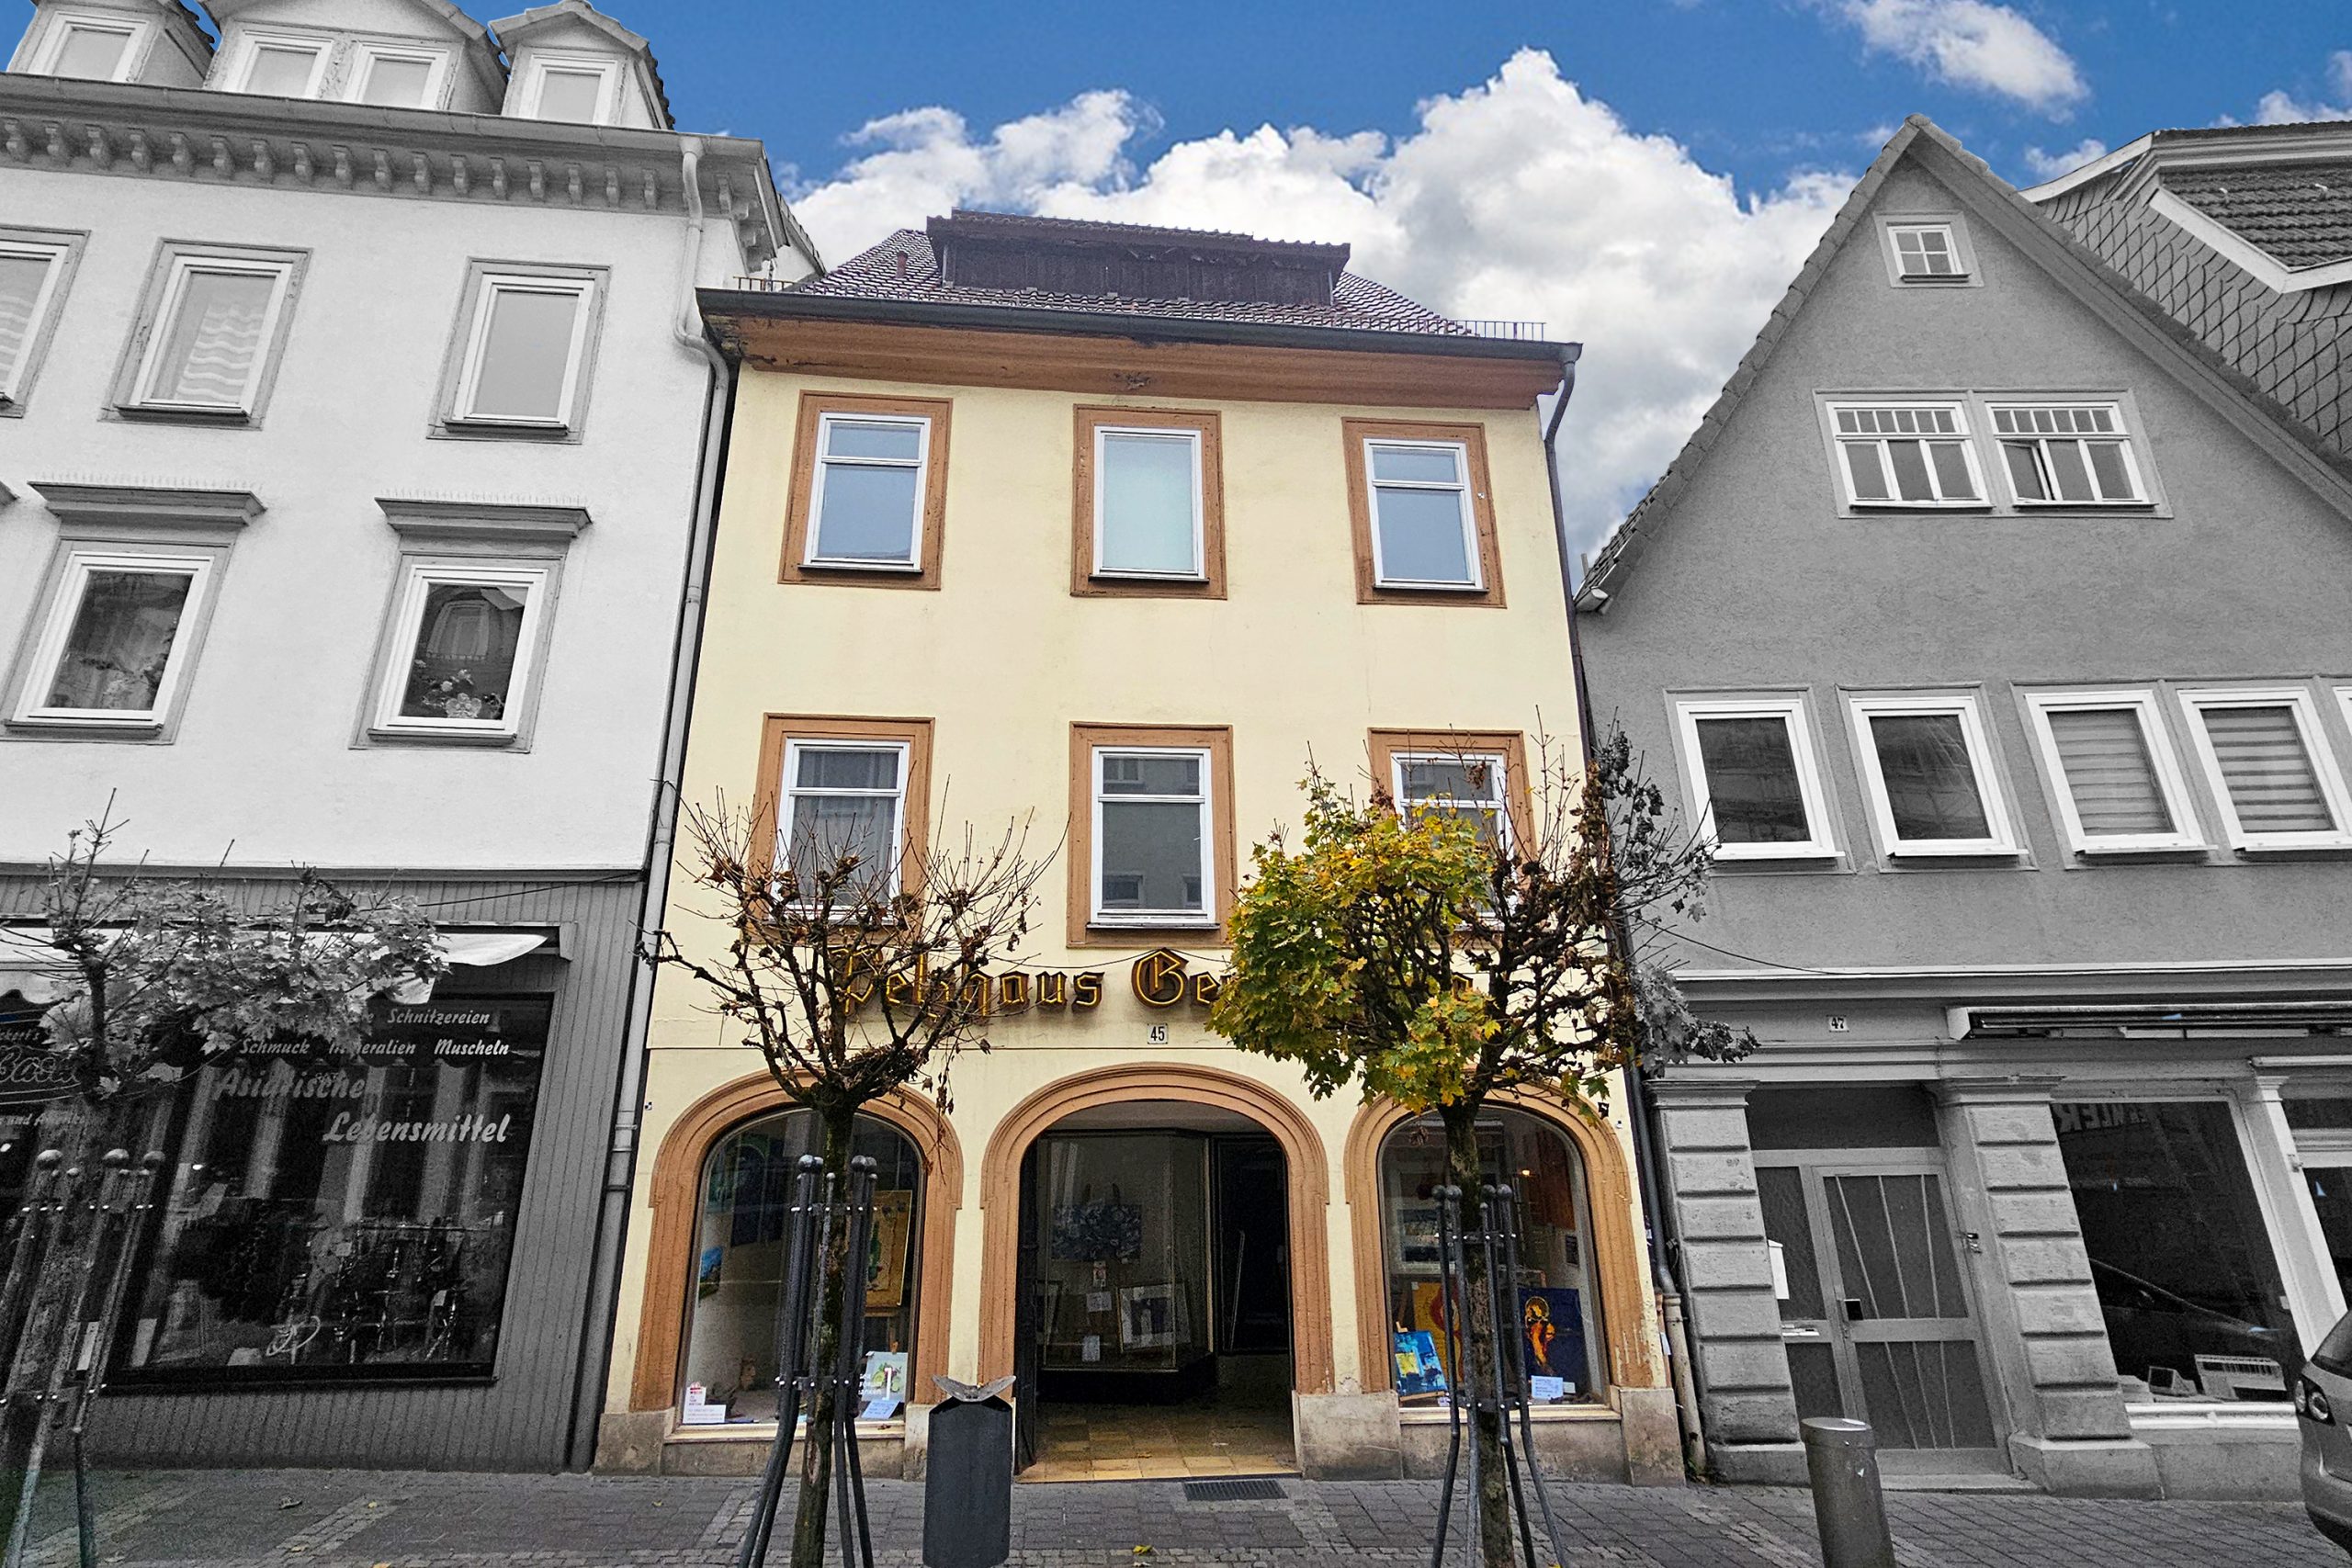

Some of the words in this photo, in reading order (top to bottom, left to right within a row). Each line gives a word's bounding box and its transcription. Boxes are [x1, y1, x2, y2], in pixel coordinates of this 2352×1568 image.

[387, 1009, 491, 1026] Schnitzereien
[1832, 1017, 1844, 1030] 47
[1150, 1026, 1165, 1042] 45
[239, 1038, 311, 1055] Schmuck
[328, 1039, 416, 1055] Meralien
[434, 1039, 510, 1055] Muscheln
[322, 1111, 511, 1143] Lebensmittel
